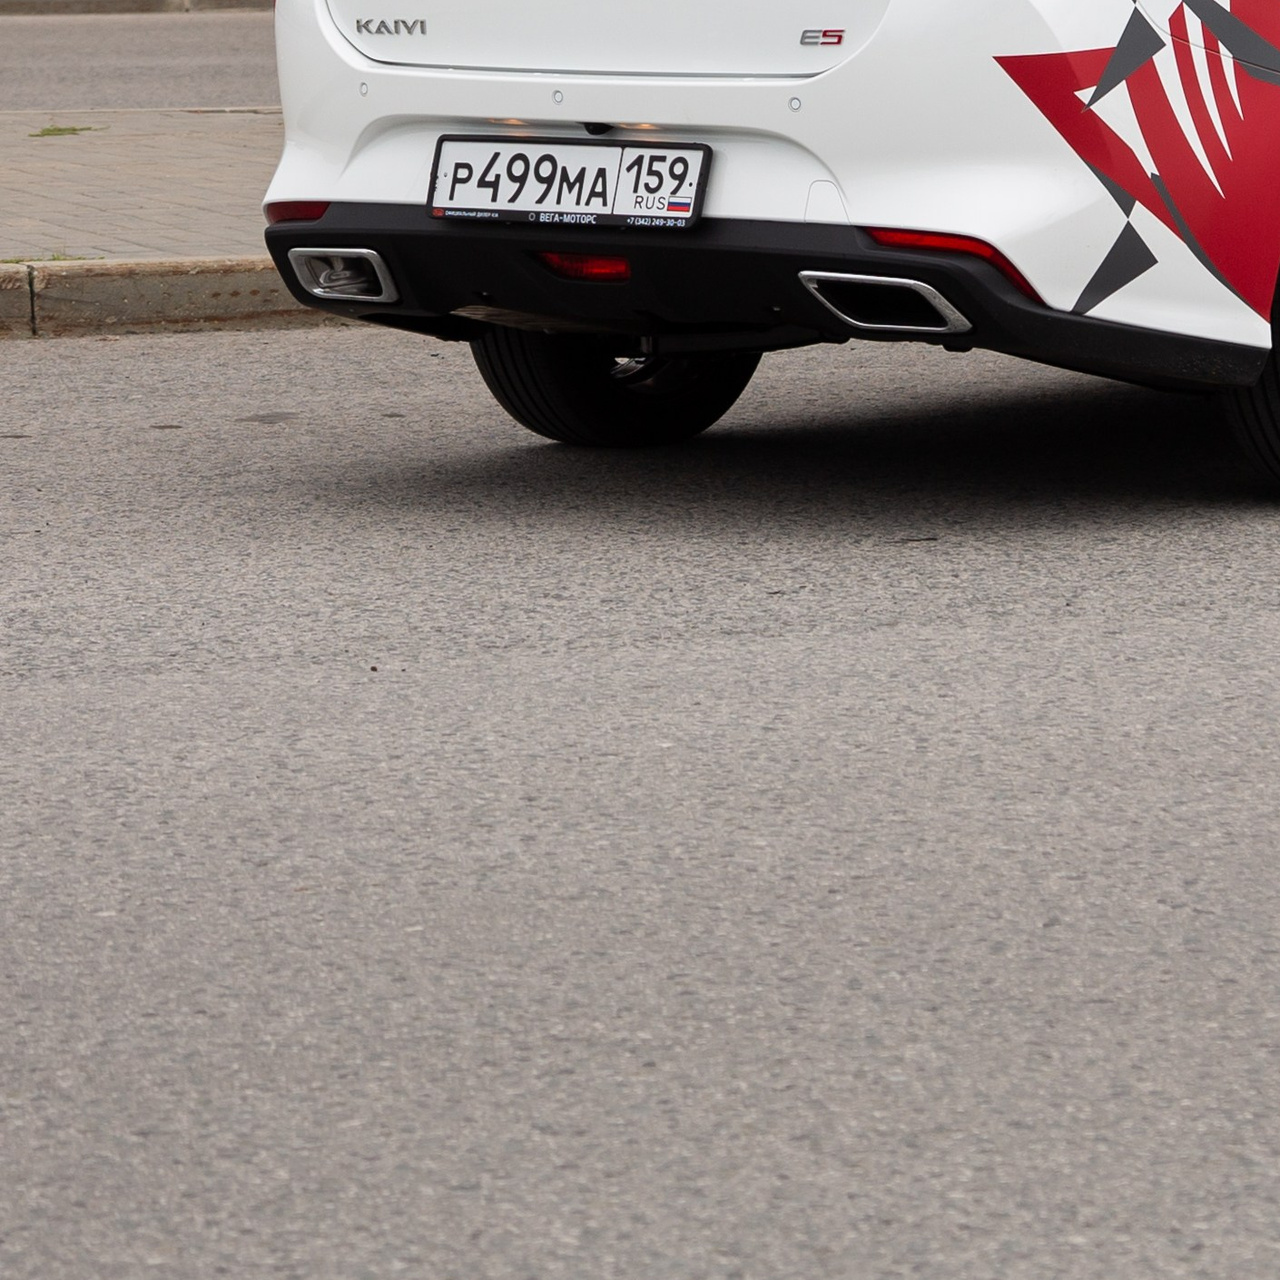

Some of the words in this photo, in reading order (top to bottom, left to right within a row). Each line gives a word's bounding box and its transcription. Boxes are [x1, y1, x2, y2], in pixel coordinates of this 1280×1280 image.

[356, 18, 427, 36] KAIYI
[449, 151, 608, 207] Р499МА
[625, 154, 690, 195] 159
[633, 195, 666, 211] RUS
[539, 213, 597, 224] ВЕГА-МОТОРС
[635, 217, 651, 226] (342)
[652, 218, 686, 227] 249-30-03
